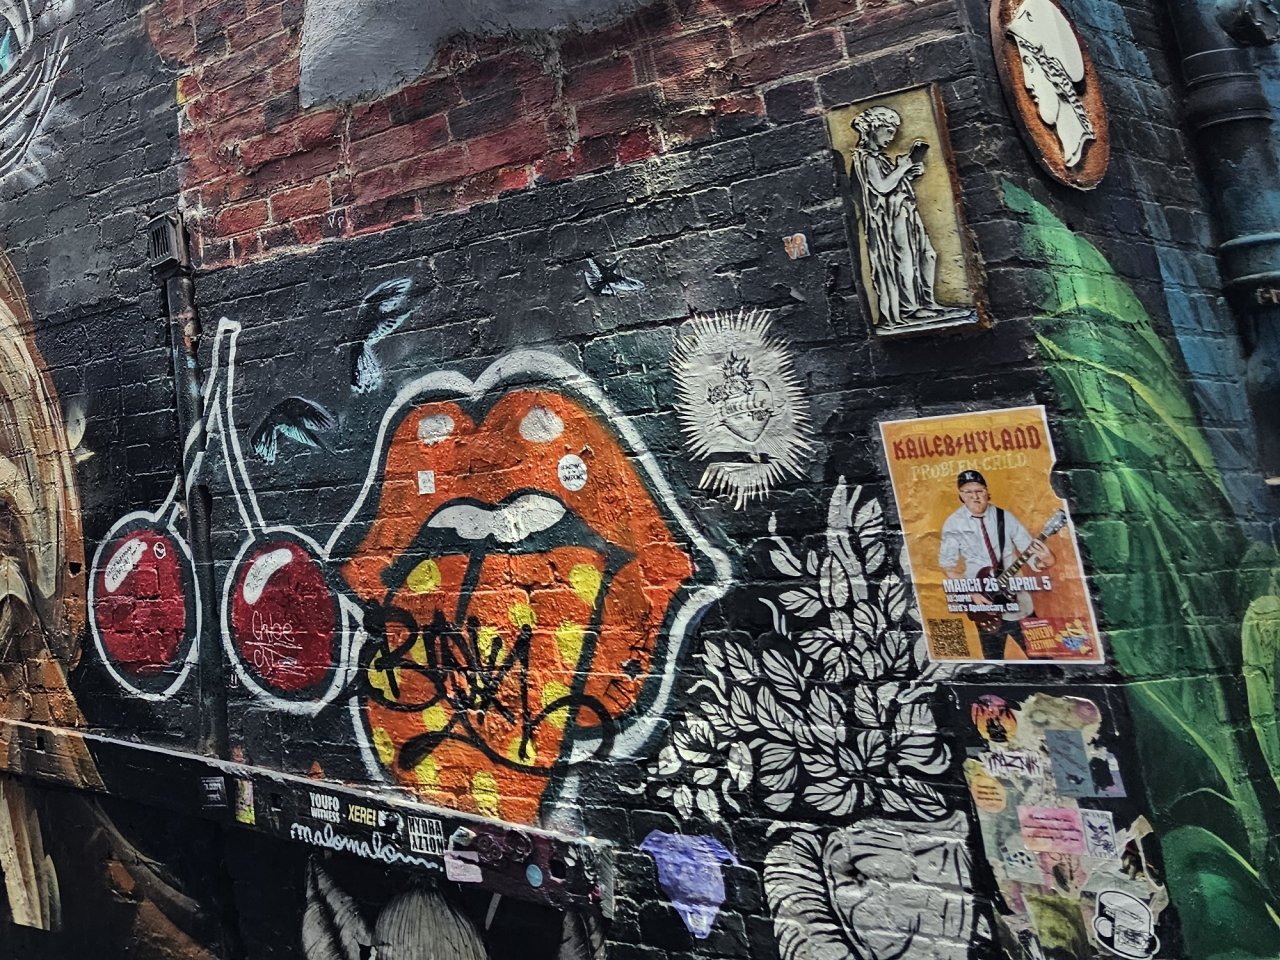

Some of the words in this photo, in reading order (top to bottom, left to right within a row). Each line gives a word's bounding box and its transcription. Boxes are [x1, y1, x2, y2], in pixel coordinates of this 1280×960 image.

[893, 434, 956, 460] KAILEB
[964, 425, 1041, 454] HYLAND
[910, 458, 979, 481] PROBLEM
[982, 451, 1027, 471] CHILD
[964, 472, 974, 480] K
[942, 578, 982, 592] MARCH
[983, 577, 1000, 592] 26
[1008, 577, 1042, 591] APRIL
[1042, 576, 1052, 590] 5
[1024, 626, 1054, 641] COMEDY
[1031, 638, 1057, 650] FESTIVAL
[309, 791, 340, 812] YOUFO
[310, 807, 340, 823] WITNESS
[408, 817, 442, 836] HYDRA
